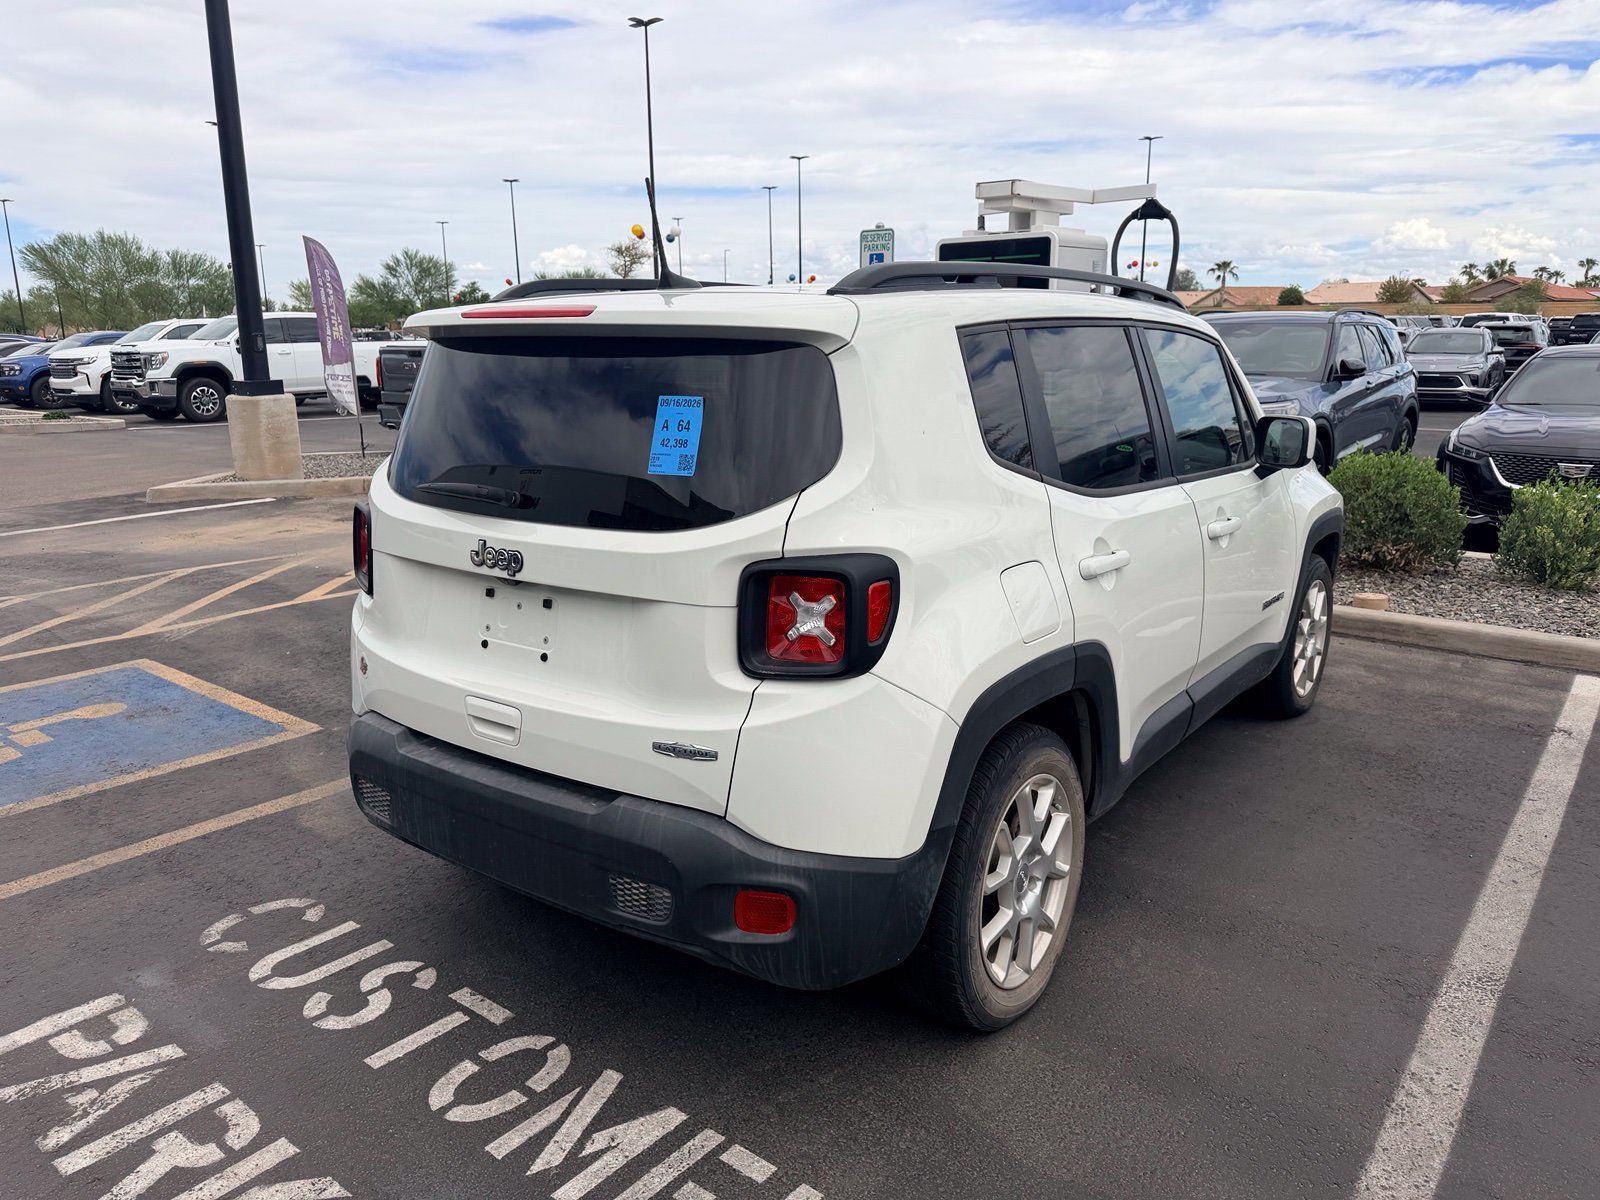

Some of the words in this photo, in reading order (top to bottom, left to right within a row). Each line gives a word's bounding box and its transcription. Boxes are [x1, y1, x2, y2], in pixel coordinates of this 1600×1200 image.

[862, 232, 892, 243] RESERVED
[863, 243, 890, 252] PARKING
[660, 399, 702, 408] 09/16/2026
[661, 419, 669, 431] A
[677, 419, 691, 432] 64
[660, 438, 688, 449] 42,398
[470, 539, 523, 577] Jeep
[200, 897, 824, 1200] CUSTOME
